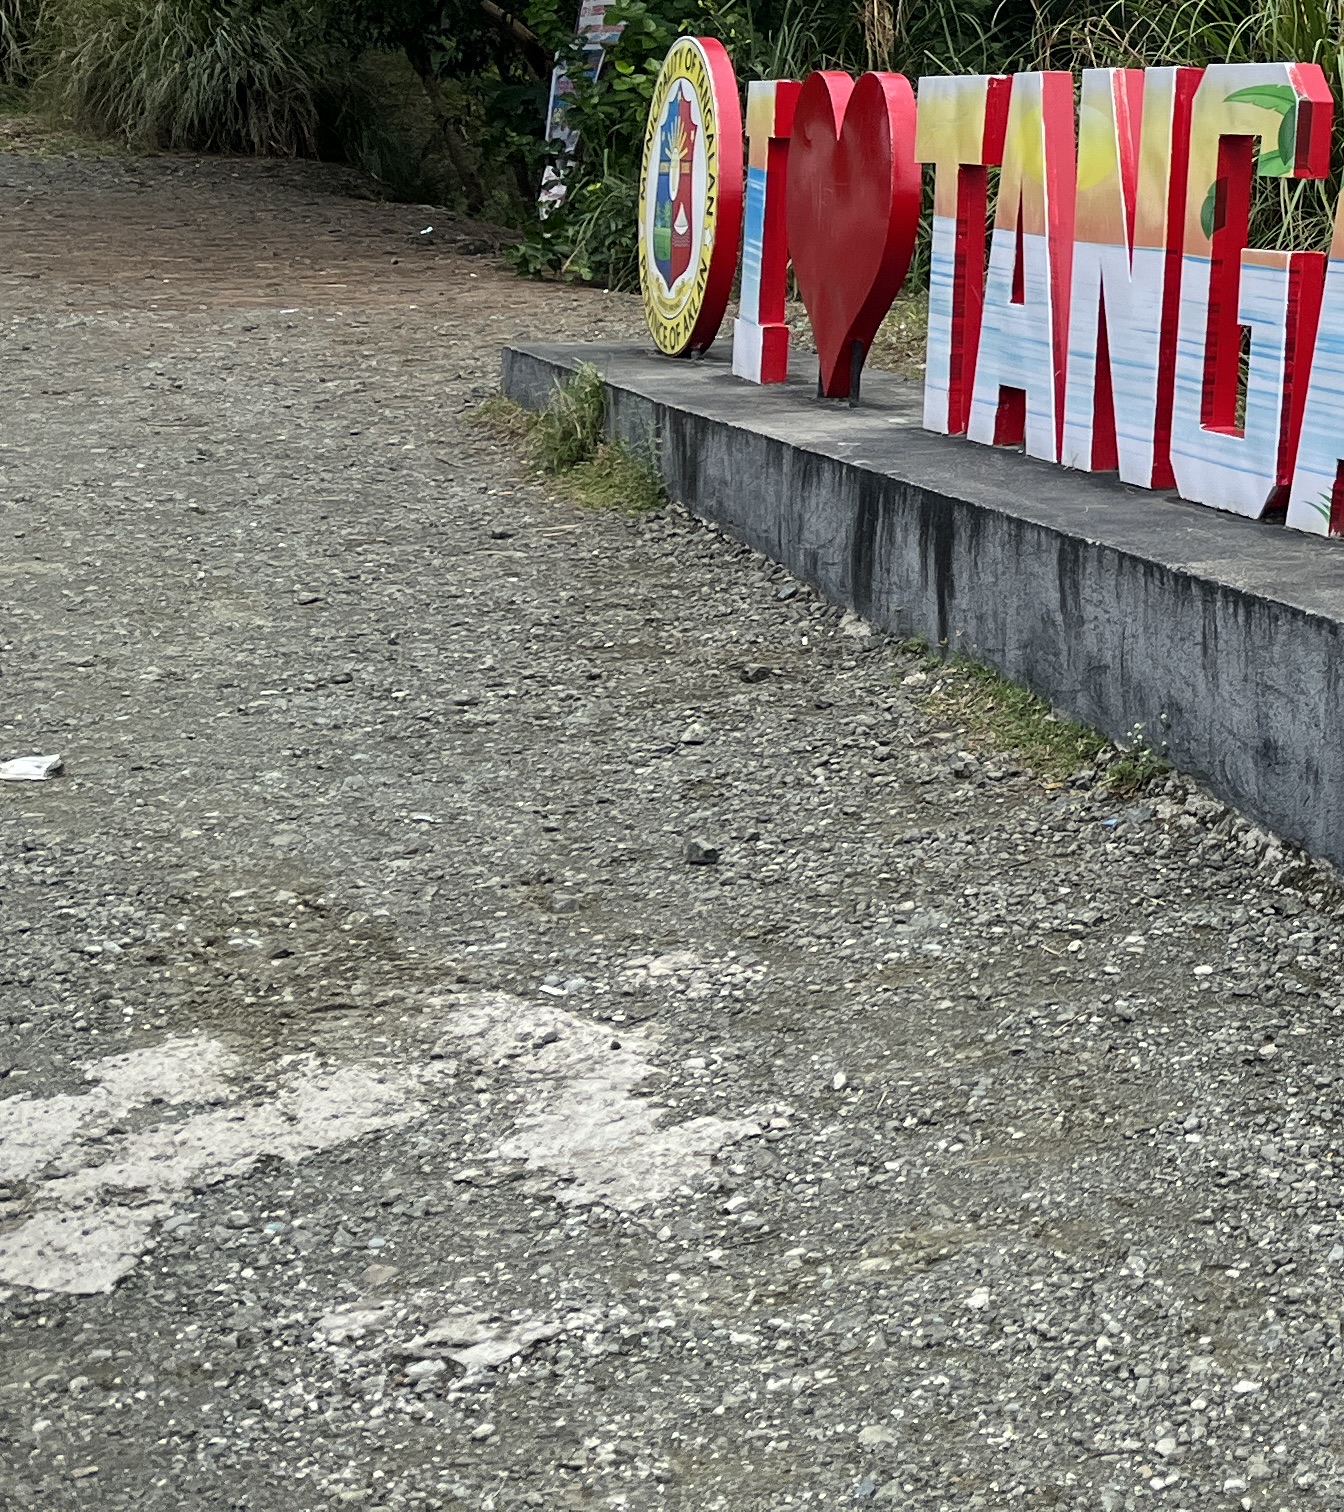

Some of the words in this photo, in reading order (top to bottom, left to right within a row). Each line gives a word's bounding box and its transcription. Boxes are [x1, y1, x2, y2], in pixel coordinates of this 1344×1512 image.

[640, 46, 685, 201] MUNICIPALITY
[684, 47, 698, 72] OF
[696, 60, 716, 217] TANGALAN
[669, 322, 681, 351] OF
[683, 257, 708, 340] AKLAN
